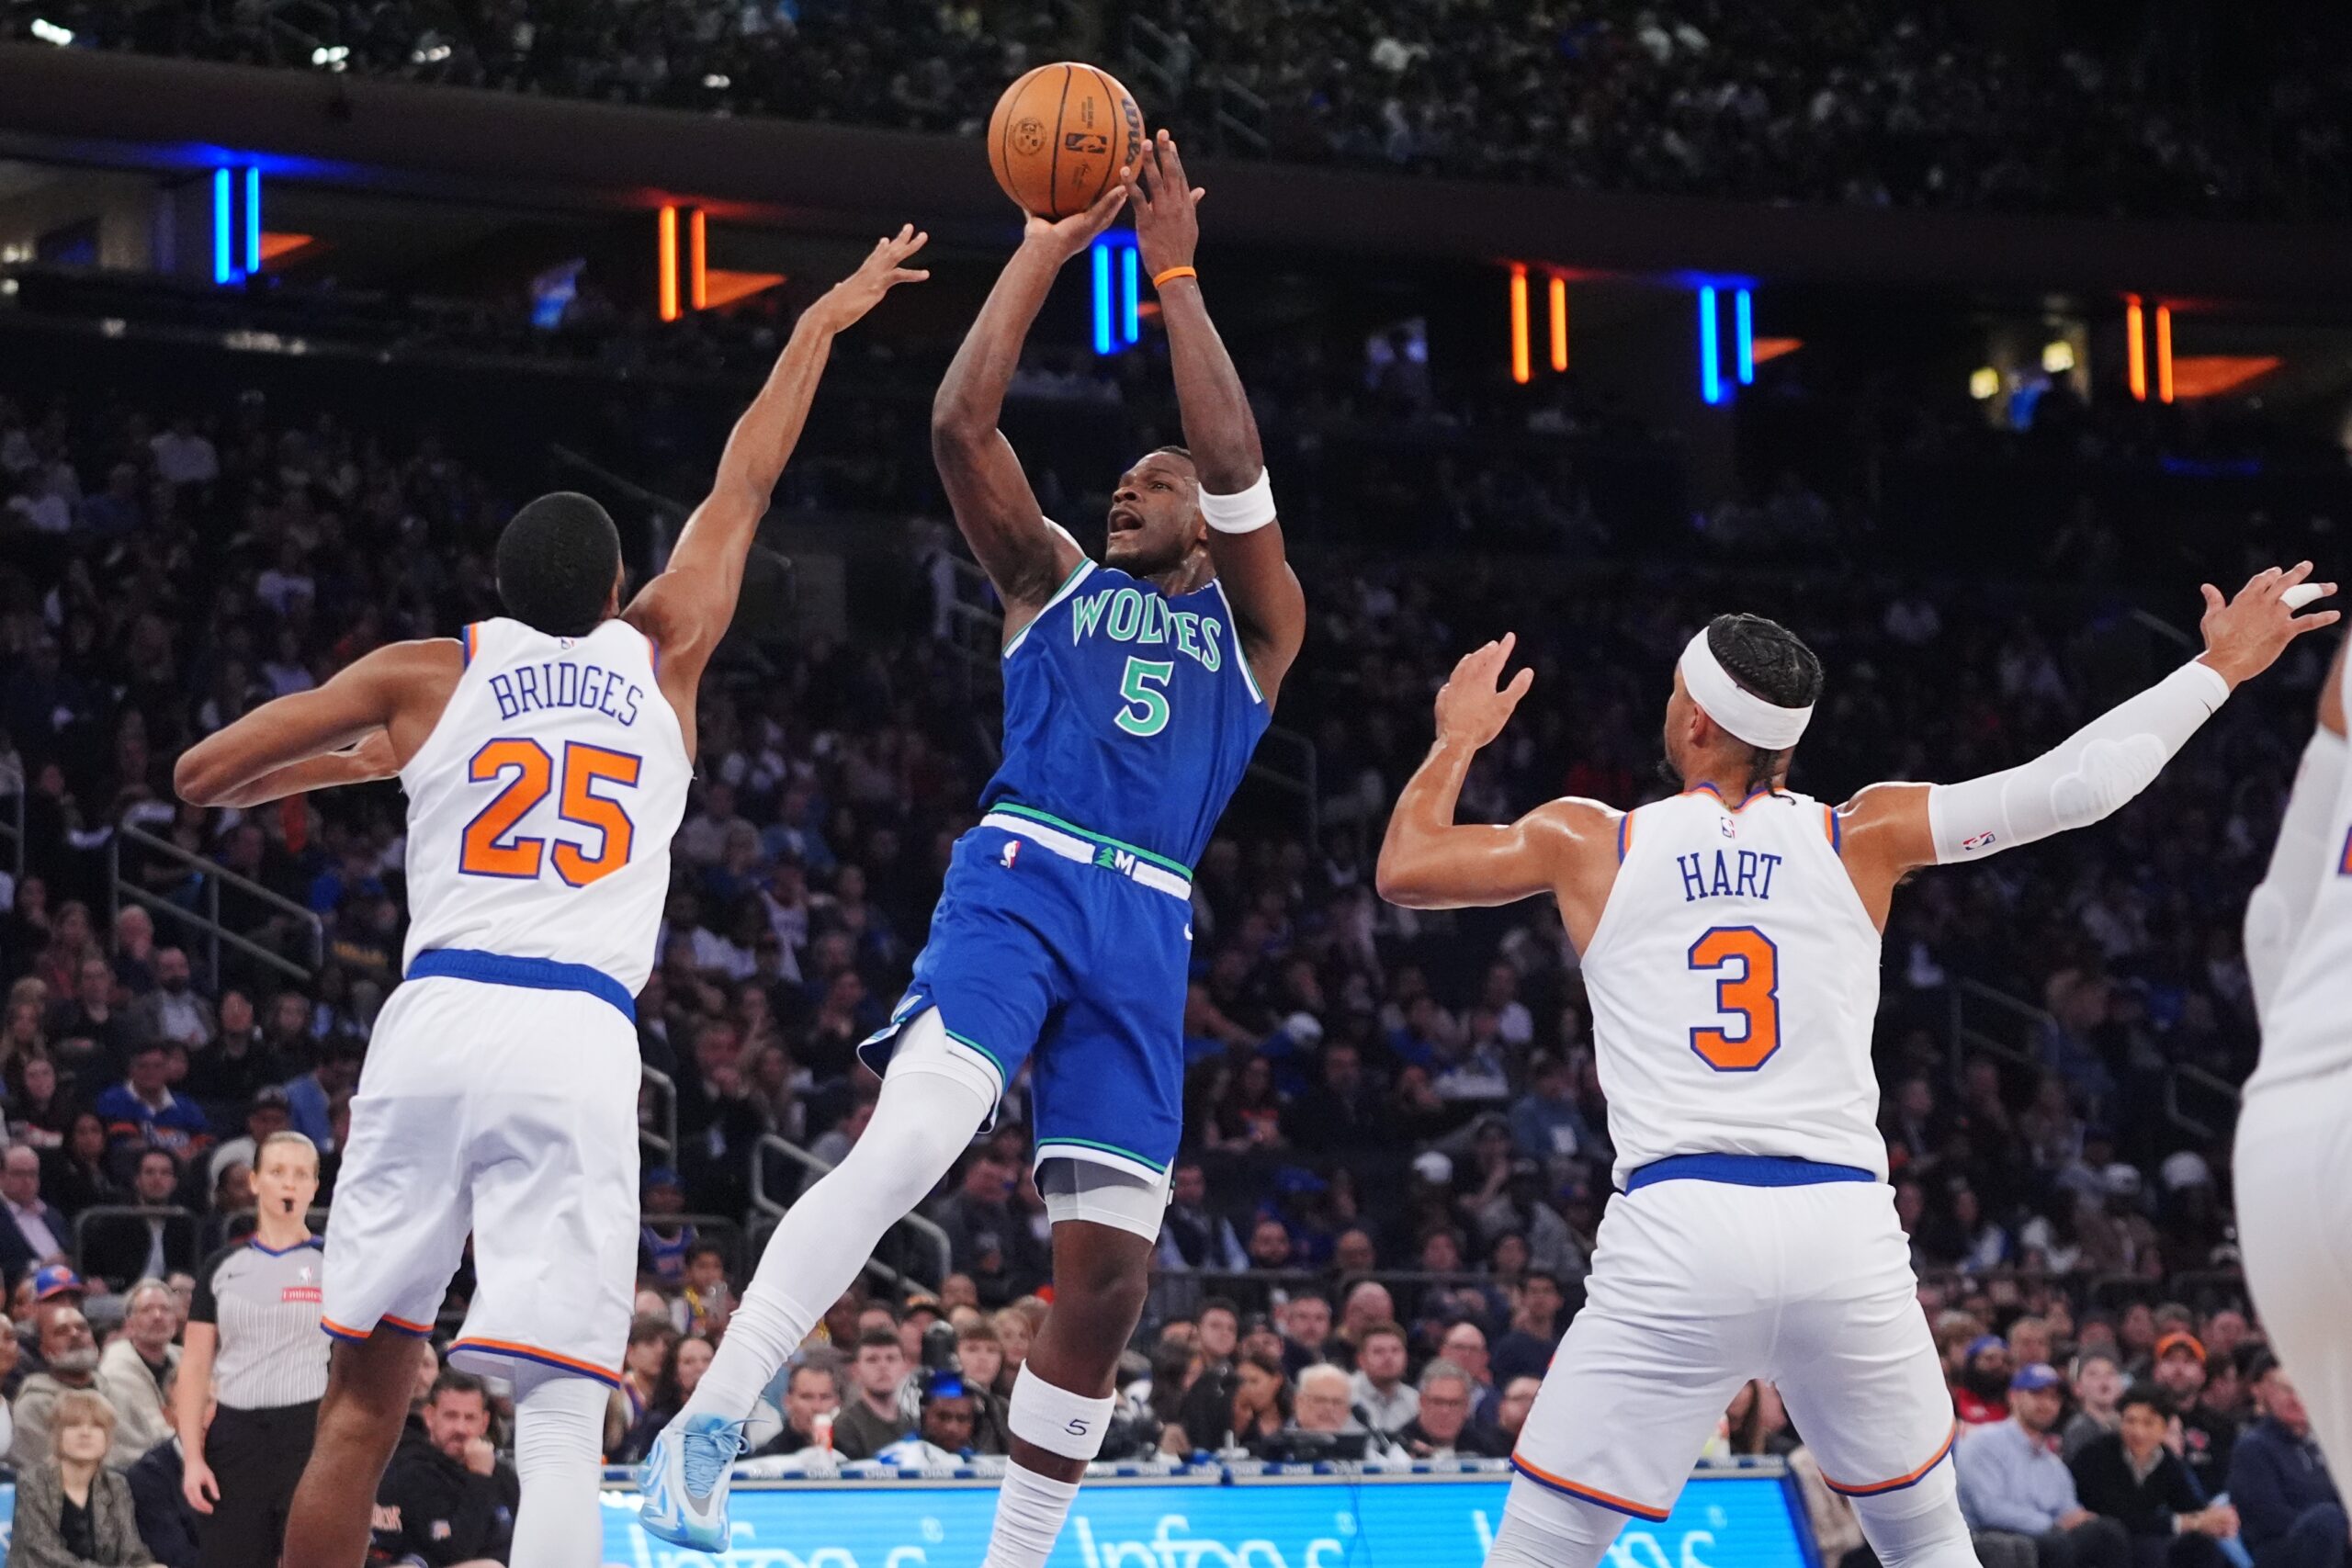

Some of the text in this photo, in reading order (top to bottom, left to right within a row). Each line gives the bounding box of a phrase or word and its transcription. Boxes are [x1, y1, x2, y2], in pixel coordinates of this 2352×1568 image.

[1072, 588, 1222, 672] WOLVES
[489, 661, 644, 727] BRIDGES
[1114, 655, 1174, 737] 5
[458, 738, 643, 888] 25
[1114, 849, 1136, 876] M
[1677, 849, 1782, 902] HART
[1688, 925, 1781, 1072] 3
[1063, 1418, 1091, 1436] 5
